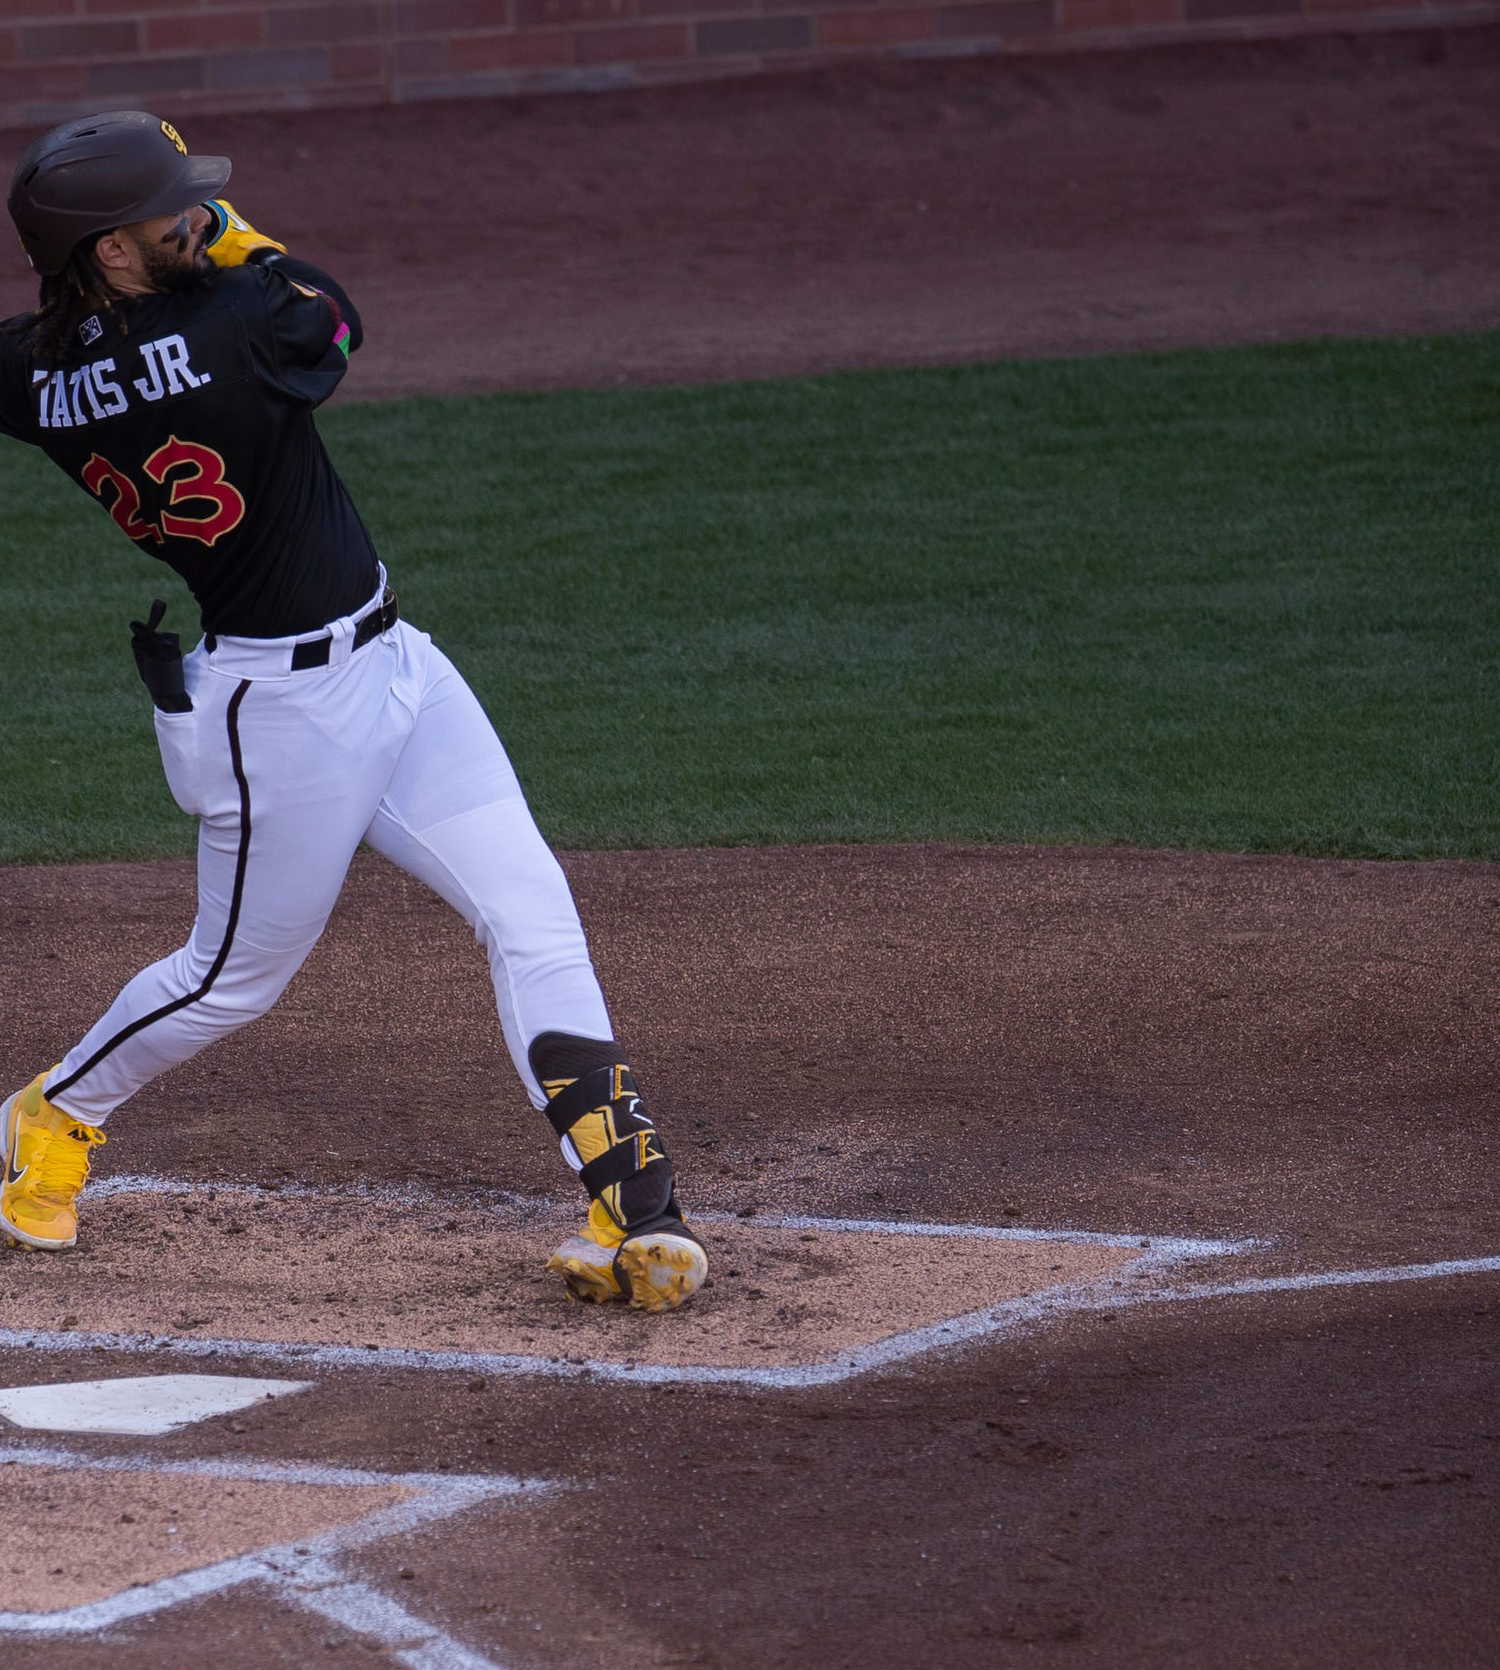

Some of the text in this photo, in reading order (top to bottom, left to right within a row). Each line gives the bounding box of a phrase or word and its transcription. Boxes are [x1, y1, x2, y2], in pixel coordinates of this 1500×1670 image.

[33, 334, 212, 427] TATIS JR.
[82, 434, 245, 546] 23
